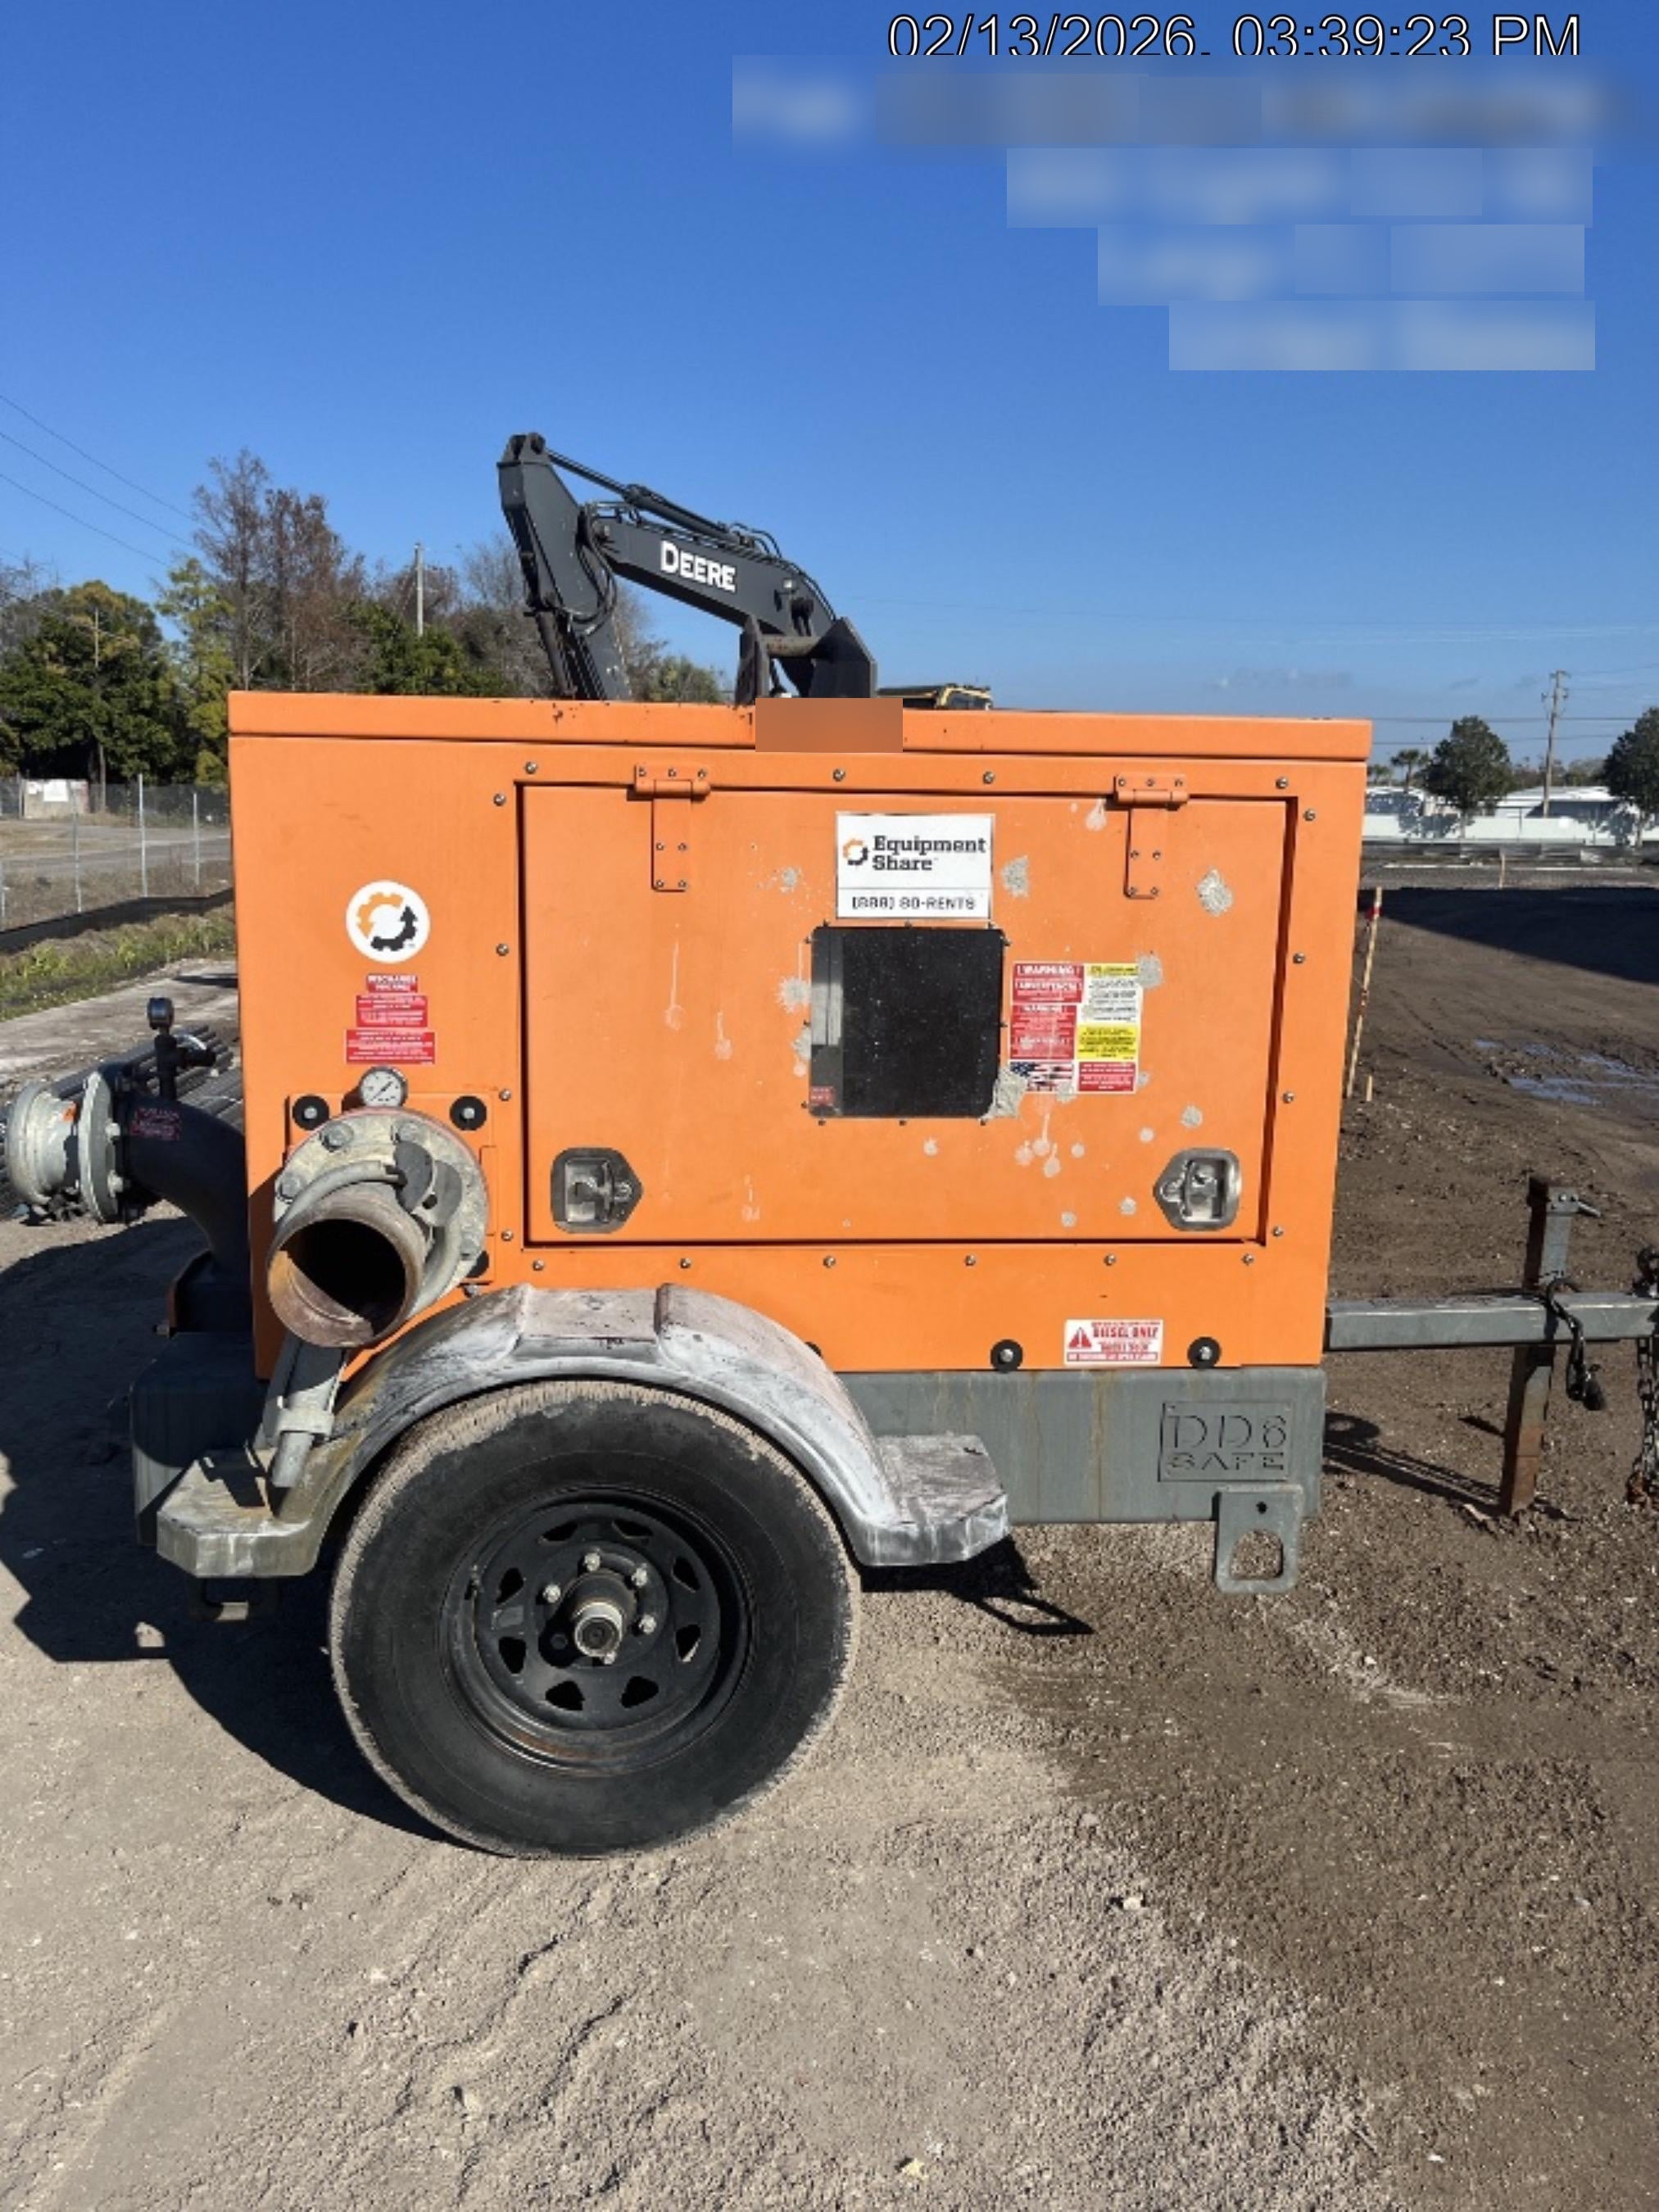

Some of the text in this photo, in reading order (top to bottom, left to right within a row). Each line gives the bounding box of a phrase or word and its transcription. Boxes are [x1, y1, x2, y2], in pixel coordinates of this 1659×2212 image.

[660, 540, 736, 593] DEERE
[873, 835, 986, 855] Equipment
[872, 855, 932, 871] Share
[1166, 1452, 1285, 1471] SAFE
